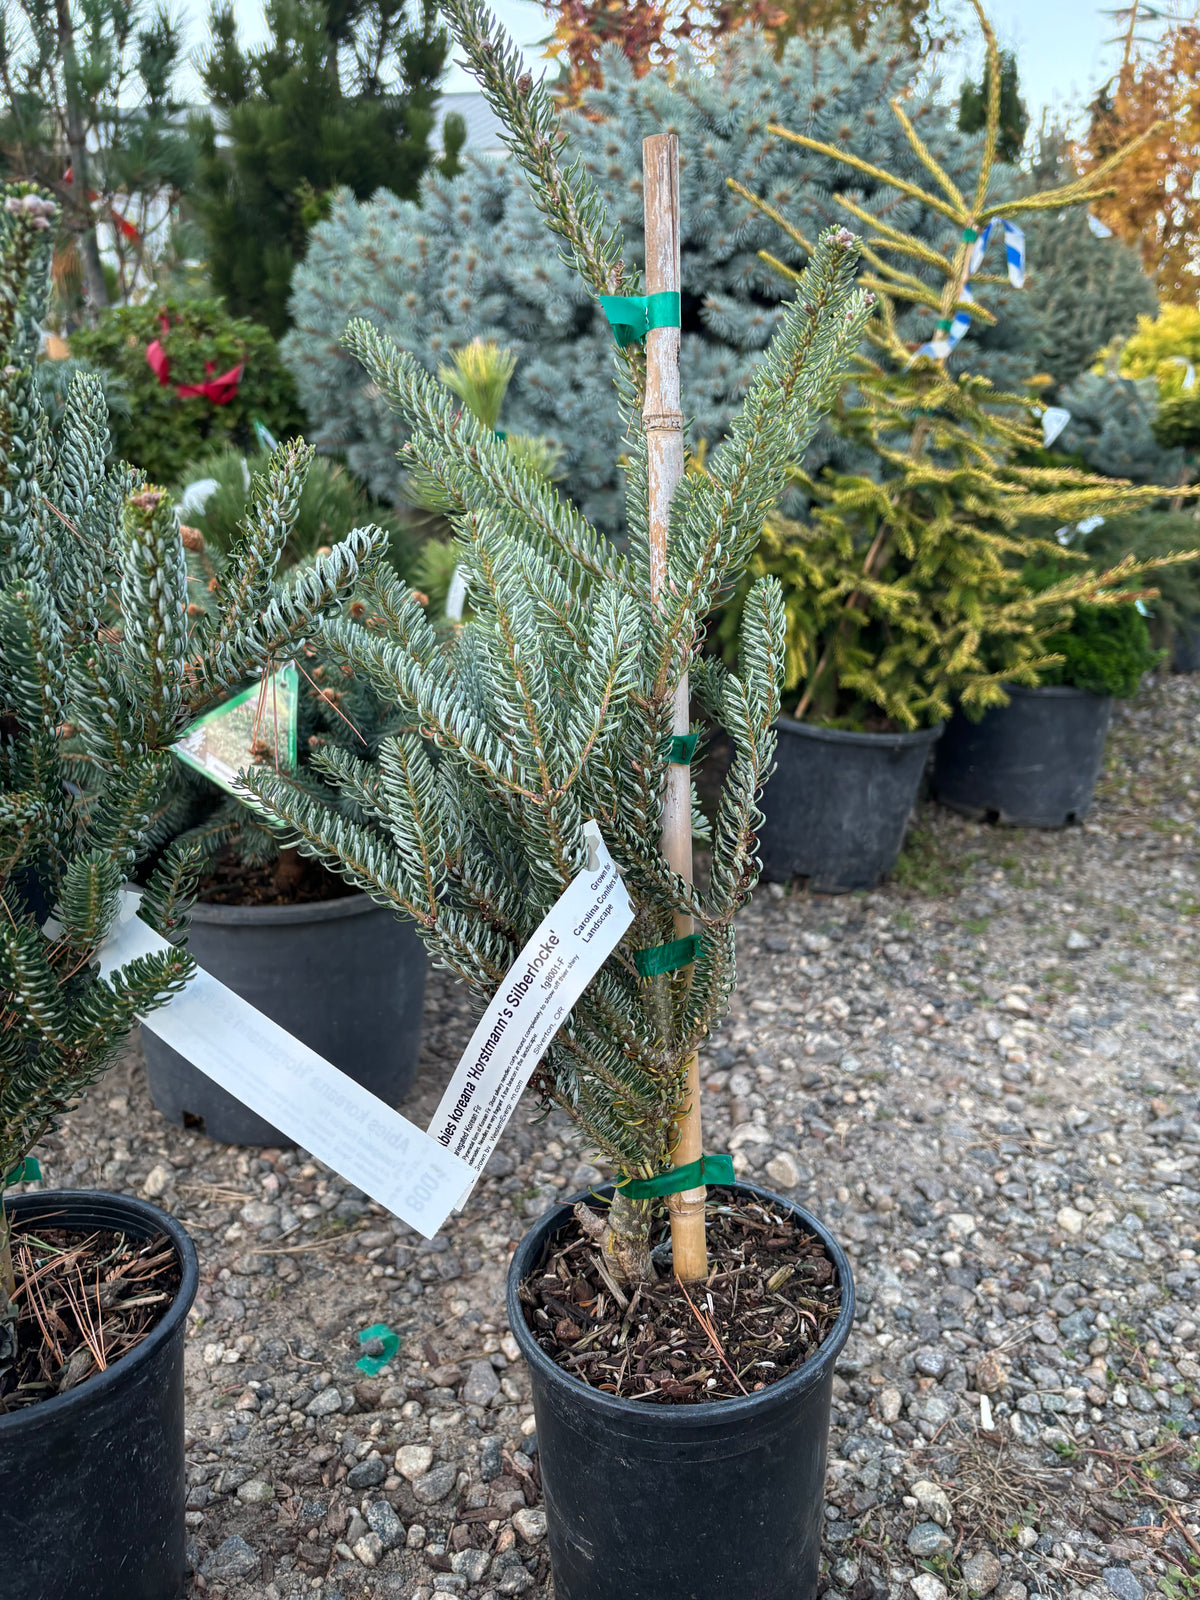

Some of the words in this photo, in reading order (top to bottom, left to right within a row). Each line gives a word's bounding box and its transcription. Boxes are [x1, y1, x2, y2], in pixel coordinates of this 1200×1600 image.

[590, 870, 607, 890] Grown
[573, 904, 599, 936] Carolina
[596, 879, 616, 904] Conifers
[582, 904, 613, 943] Landscape
[540, 956, 564, 990] 1g8001-F
[448, 1082, 476, 1123] koreana
[466, 1008, 513, 1080] 'Horstmann's
[506, 929, 559, 1007] Silberlocke'
[554, 1006, 564, 1020] OR
[479, 1113, 488, 1127] Korean
[501, 1066, 511, 1083] needles
[515, 1037, 526, 1055] around
[524, 1010, 543, 1038] completely
[544, 990, 555, 1004] show
[567, 954, 579, 968] shiny
[454, 1131, 469, 1156] ariegated
[464, 1113, 478, 1132] Korean
[473, 1104, 481, 1114] Fir
[478, 1130, 489, 1145] Needles
[506, 1071, 517, 1087] beacon
